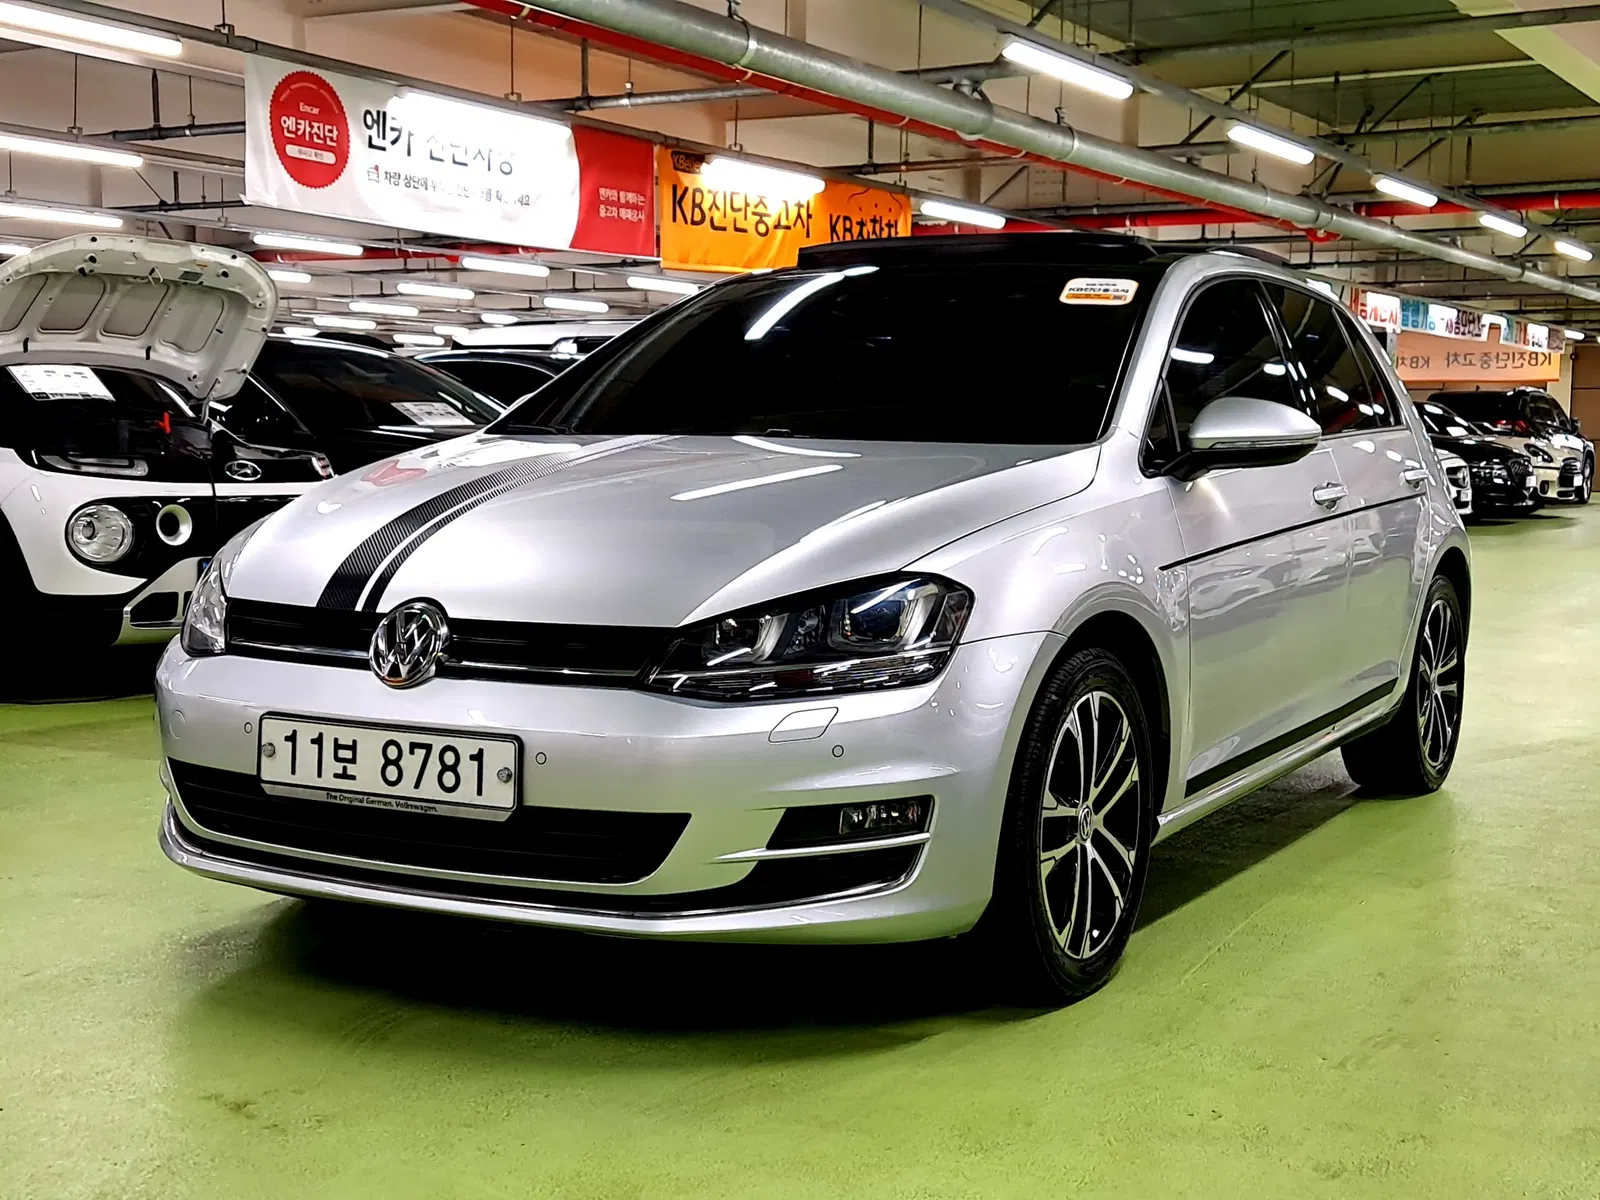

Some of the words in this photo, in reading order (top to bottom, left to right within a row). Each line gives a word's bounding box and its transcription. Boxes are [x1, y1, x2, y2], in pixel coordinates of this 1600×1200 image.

[280, 115, 339, 147] 엔카진단
[363, 109, 414, 158] 엔카
[383, 170, 401, 187] 차량
[671, 183, 814, 239] KB진단중고차
[284, 728, 358, 781] 11보
[380, 738, 485, 797] 8781
[326, 792, 338, 801] The
[339, 794, 365, 804] Original
